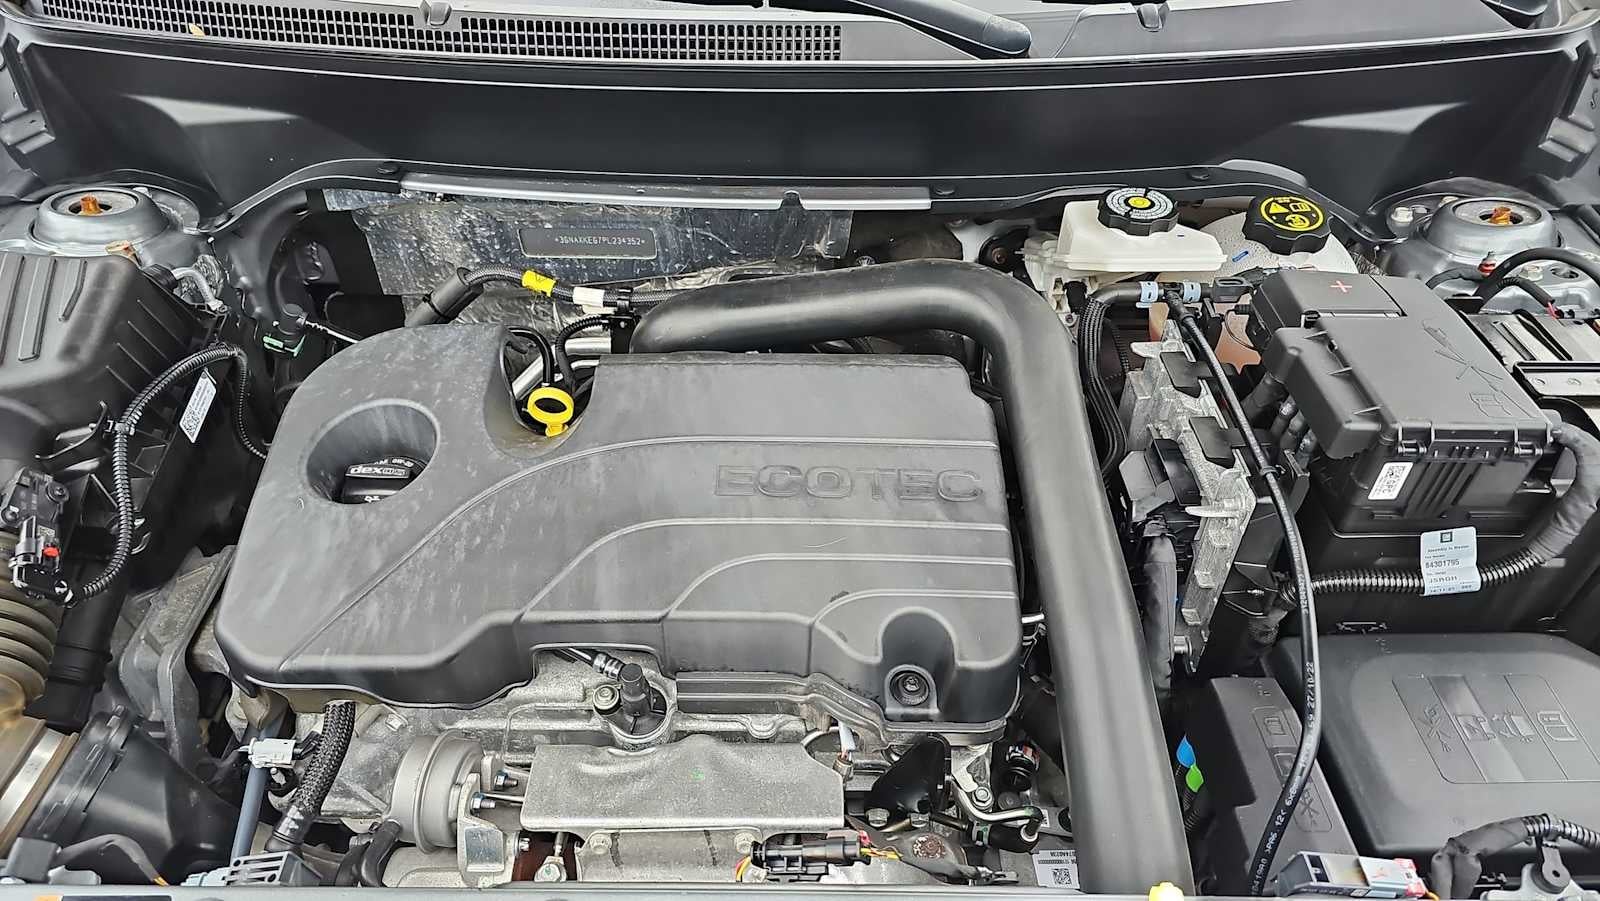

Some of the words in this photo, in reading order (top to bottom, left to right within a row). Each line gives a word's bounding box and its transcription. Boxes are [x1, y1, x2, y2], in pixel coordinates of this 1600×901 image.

[350, 465, 406, 477] dexos
[714, 464, 984, 502] ECOTEC
[1305, 661, 1315, 709] 27/10/22
